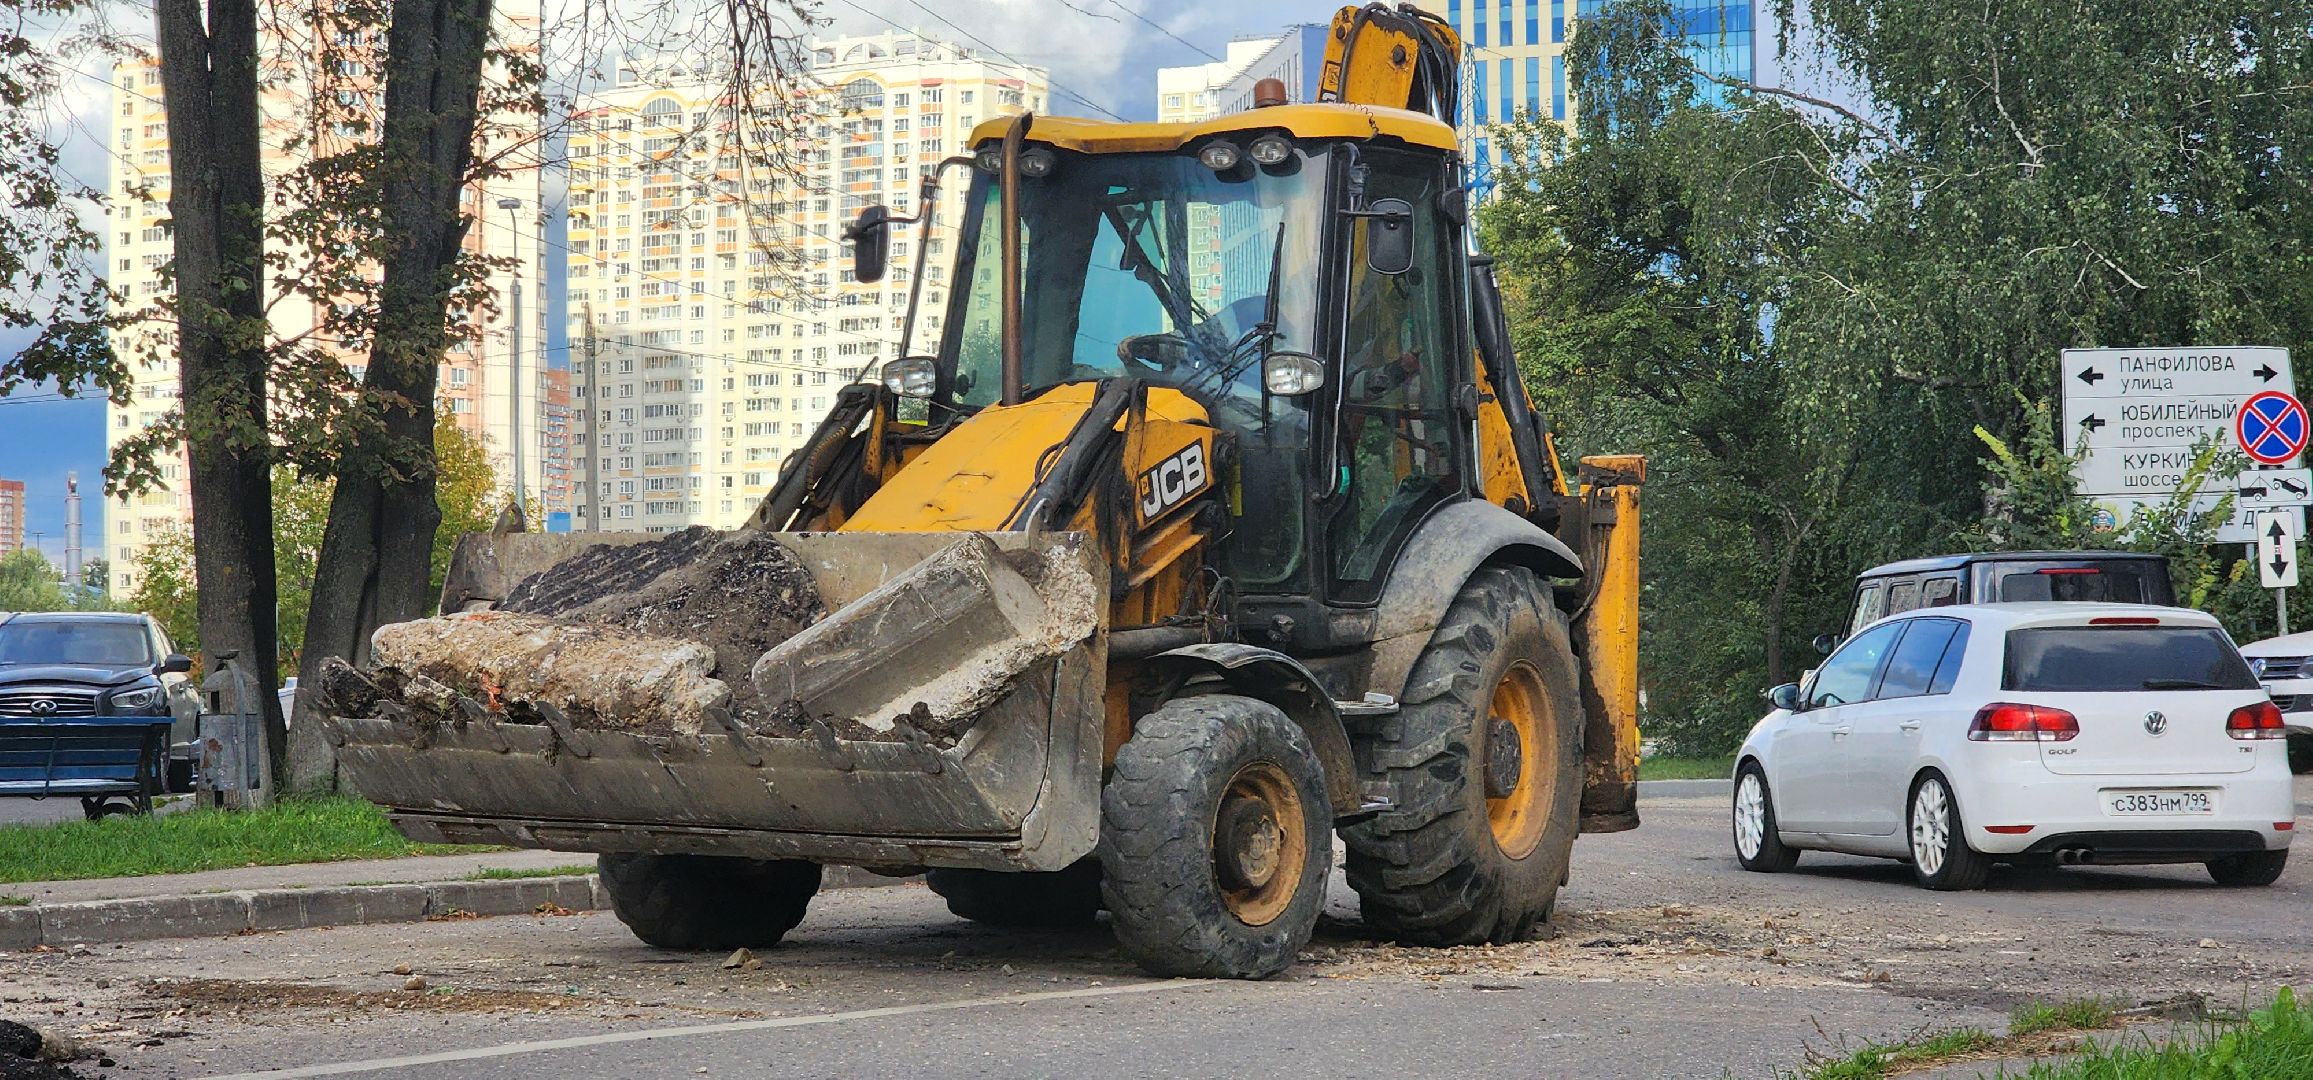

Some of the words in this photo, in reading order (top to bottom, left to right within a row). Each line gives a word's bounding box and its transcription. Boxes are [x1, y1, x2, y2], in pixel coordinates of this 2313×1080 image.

[2120, 355, 2236, 373] ПАНФИЛОВА
[2121, 378, 2174, 394] улица
[2121, 399, 2238, 421] ЮБИЛЕЙНЫЙ
[2122, 425, 2205, 442] проспект
[1143, 444, 1206, 518] JCB
[2124, 474, 2182, 487] шоссе
[2183, 793, 2207, 806] 799
